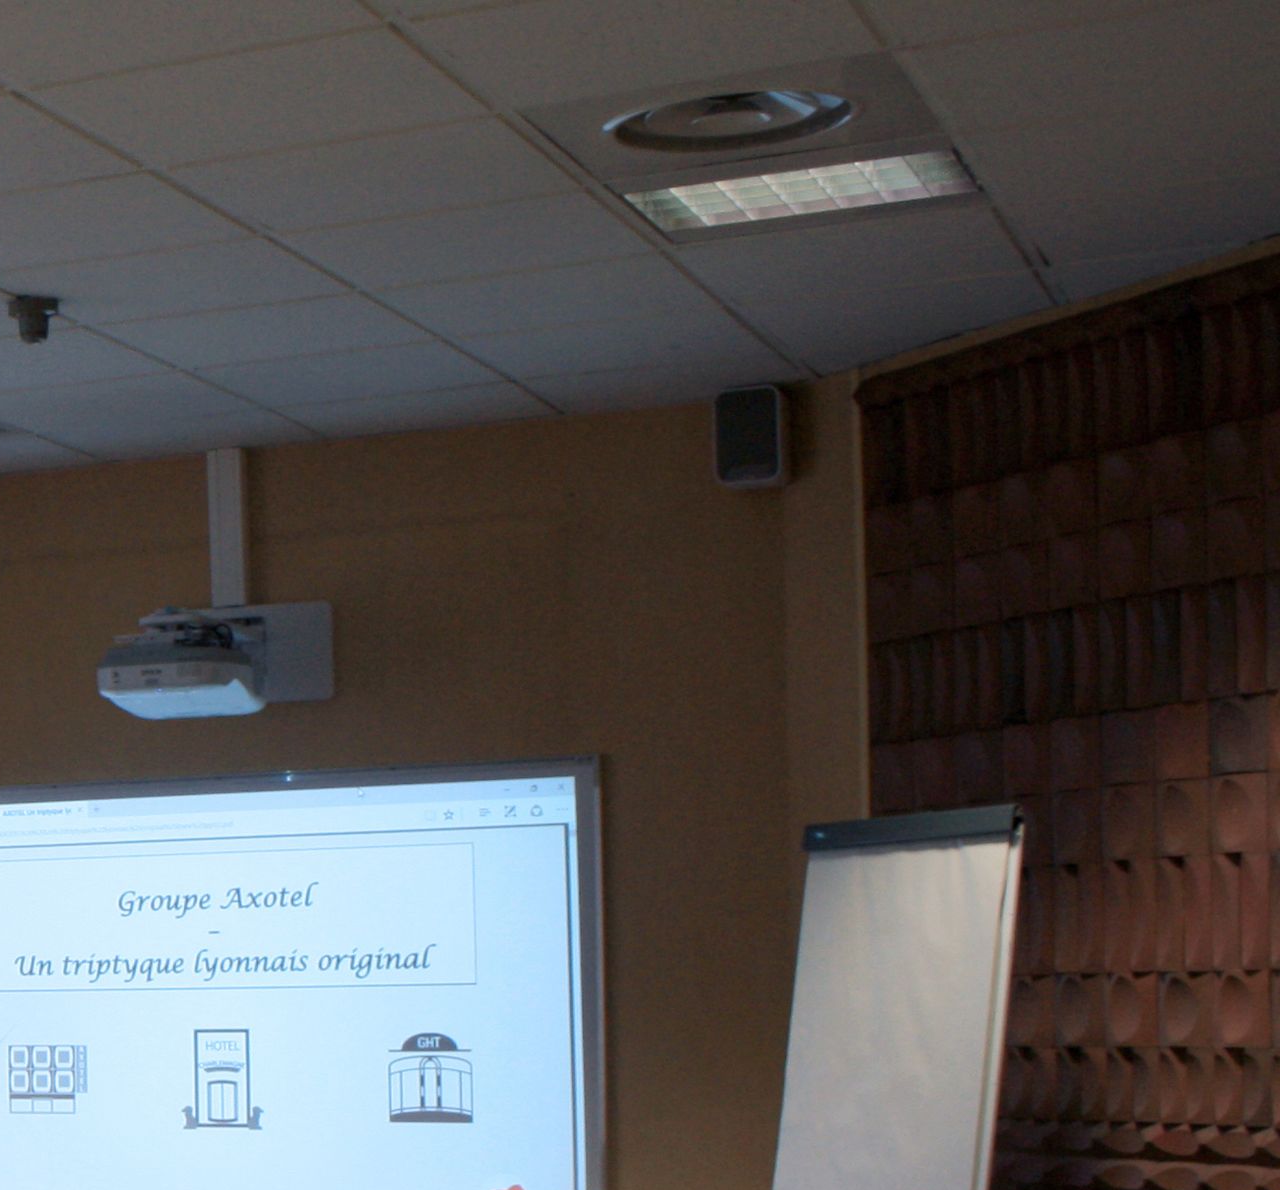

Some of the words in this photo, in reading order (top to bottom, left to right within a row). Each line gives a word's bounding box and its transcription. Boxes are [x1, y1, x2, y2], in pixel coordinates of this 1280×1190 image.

[117, 890, 211, 919] Groupe
[219, 882, 319, 911] Axotel
[14, 955, 54, 977] Un
[62, 953, 184, 983] triptyque
[193, 948, 308, 980] lyonnais
[317, 943, 437, 979] original
[205, 1040, 241, 1051] HOTEL
[416, 1036, 441, 1049] GHT
